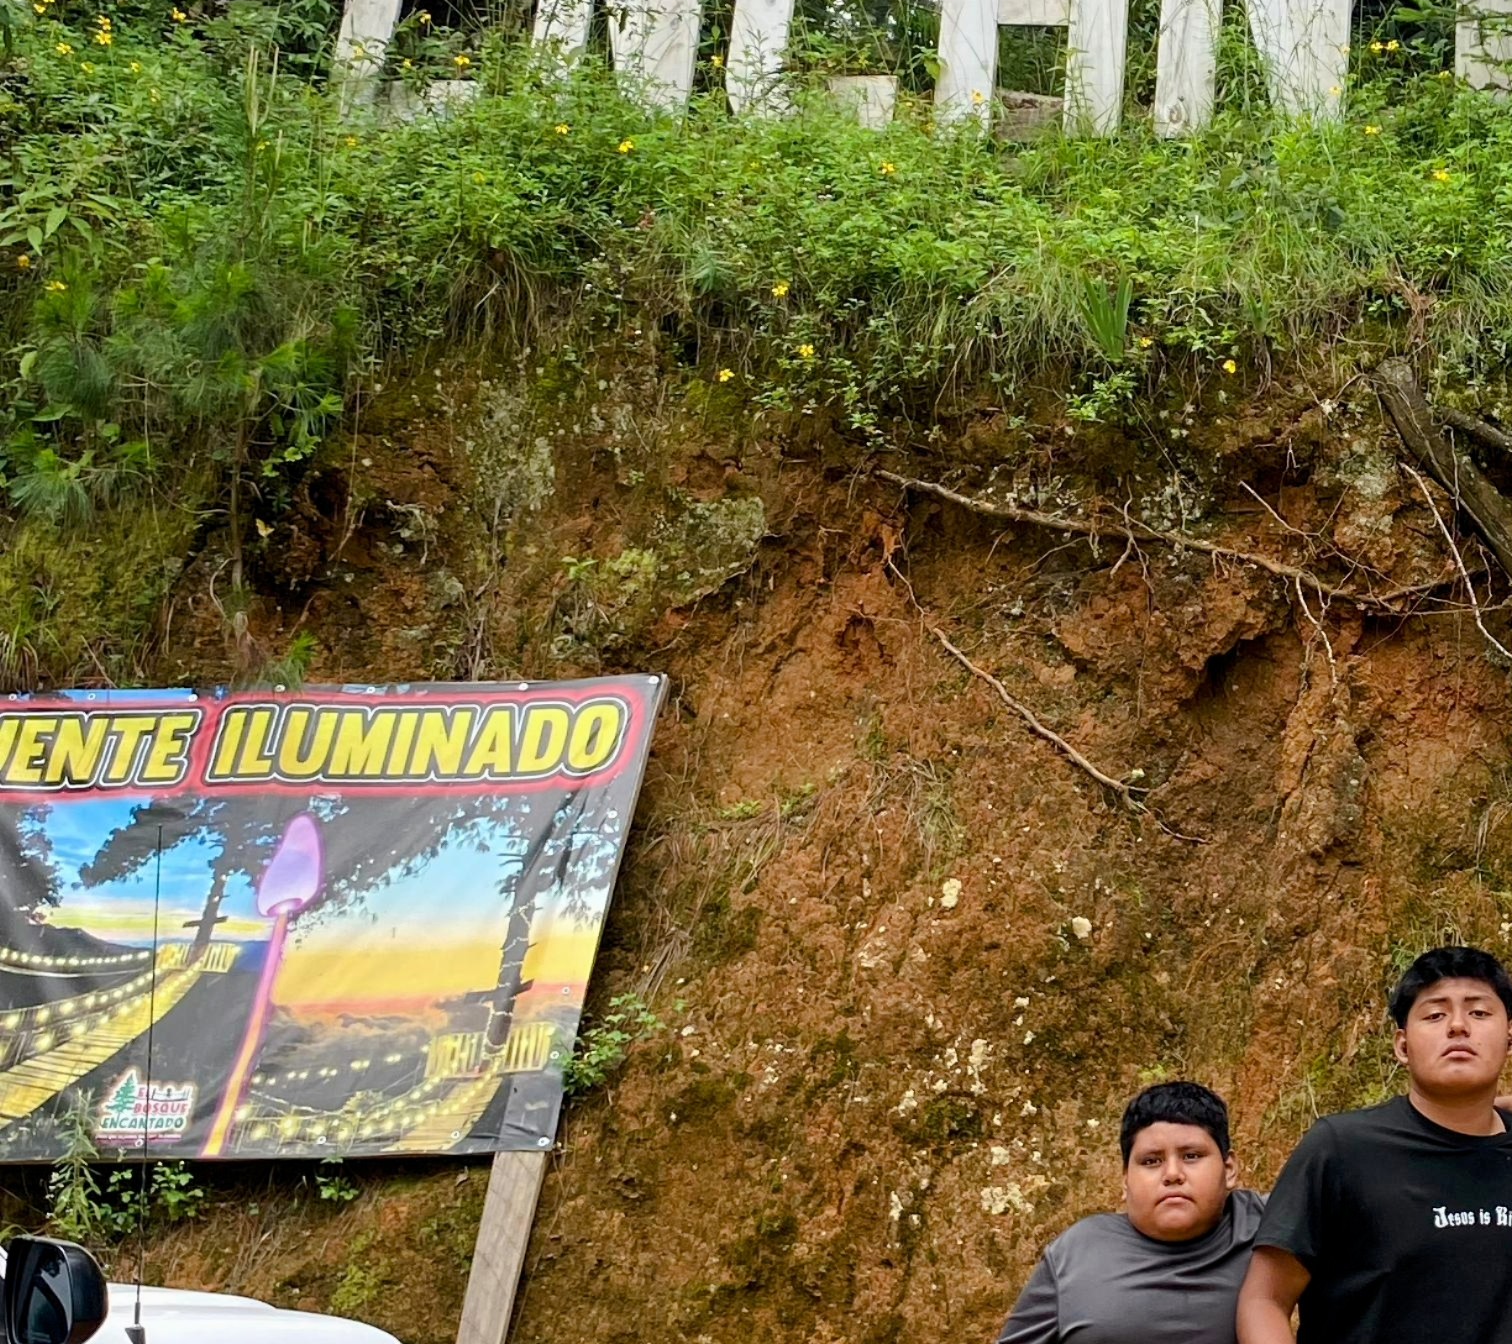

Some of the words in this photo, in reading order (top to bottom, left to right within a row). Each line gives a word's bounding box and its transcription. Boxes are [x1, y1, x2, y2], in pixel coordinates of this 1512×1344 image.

[213, 701, 627, 777] ILUMINADO
[133, 1102, 189, 1114] BOSQUE
[100, 1116, 185, 1129] ENCANTADO
[1432, 1206, 1476, 1229] Jesus
[1479, 1208, 1491, 1225] is
